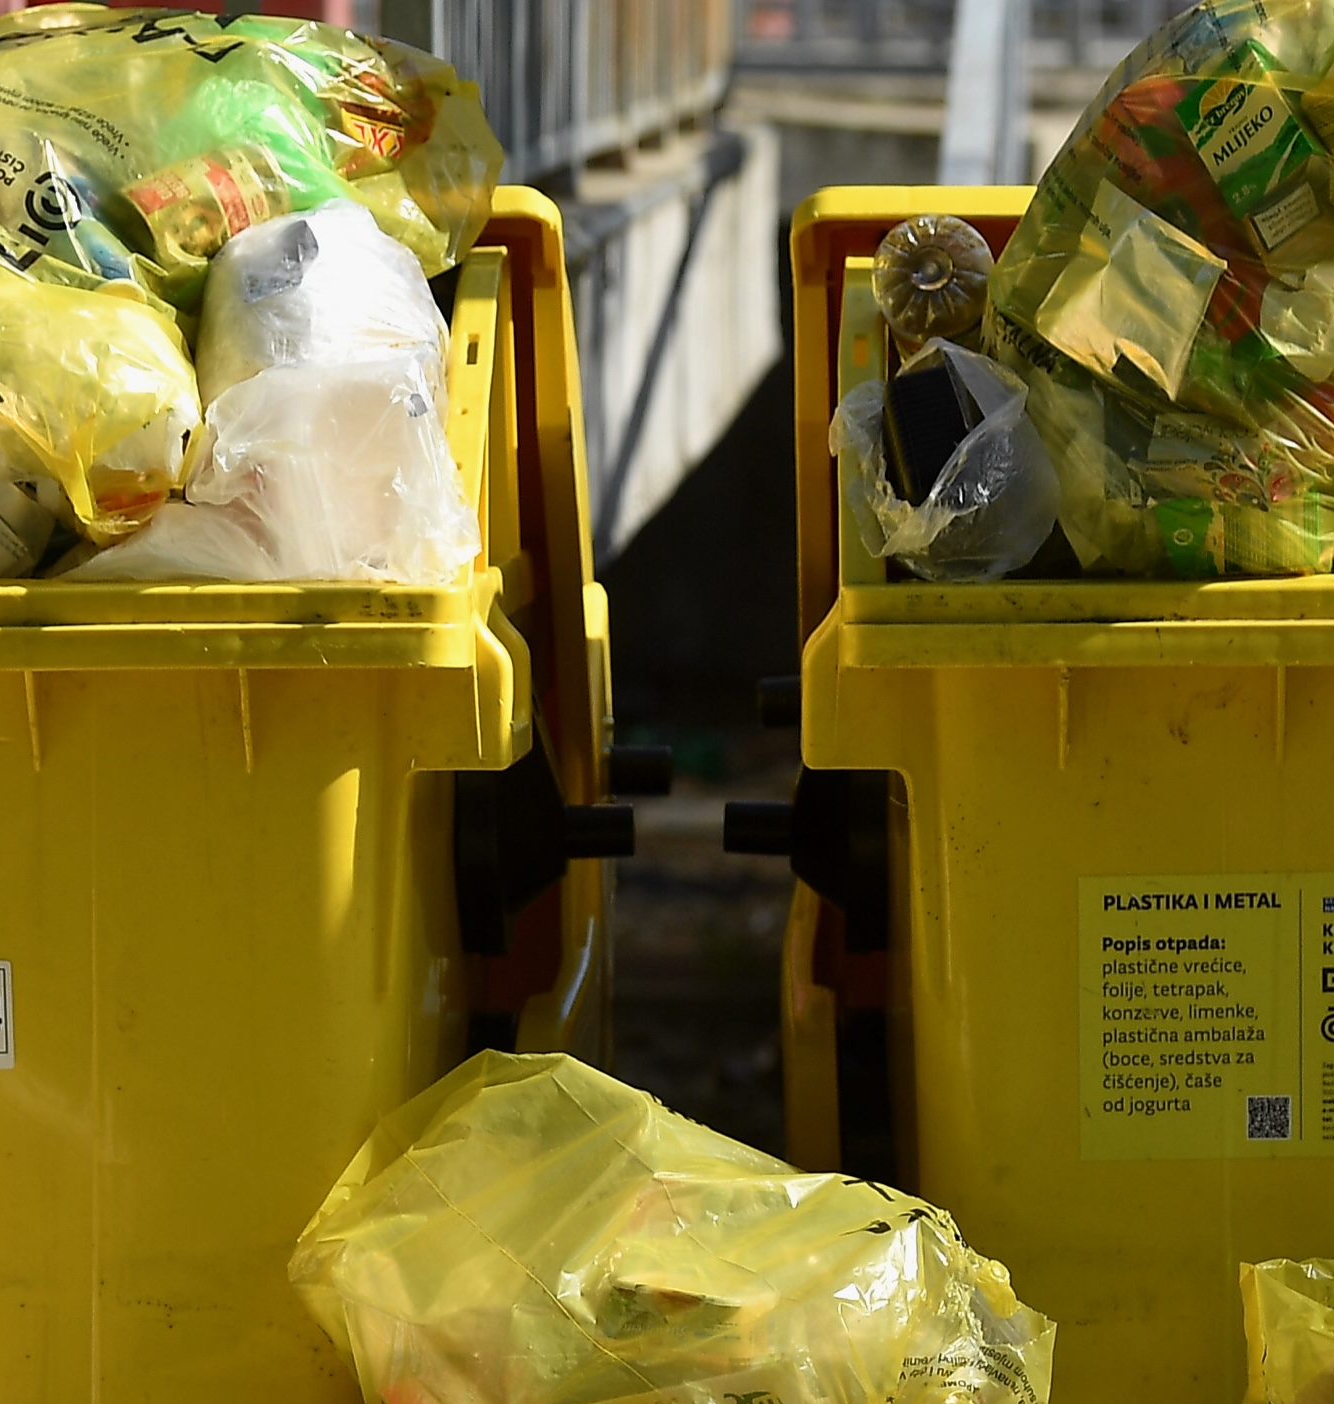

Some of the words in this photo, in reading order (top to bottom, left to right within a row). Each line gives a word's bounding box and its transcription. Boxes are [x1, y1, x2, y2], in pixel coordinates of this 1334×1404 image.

[1212, 105, 1274, 167] MLIJEKO
[1103, 894, 1198, 911] PLASTIKA
[1215, 892, 1282, 909] METAL
[1102, 935, 1151, 956] Popis
[1155, 934, 1227, 955] otpada:
[1103, 959, 1179, 978] plastične
[1183, 957, 1247, 975] vrećice,
[1153, 980, 1229, 1000] tetrapak,
[1188, 1003, 1259, 1021] limenke,
[1103, 1029, 1179, 1048] plastična
[1183, 1026, 1265, 1043] ambalaža
[1159, 1049, 1231, 1066] sredstva
[1184, 1072, 1223, 1088] čaše
[1103, 1096, 1124, 1113] od
[1128, 1096, 1191, 1116] jogurta
